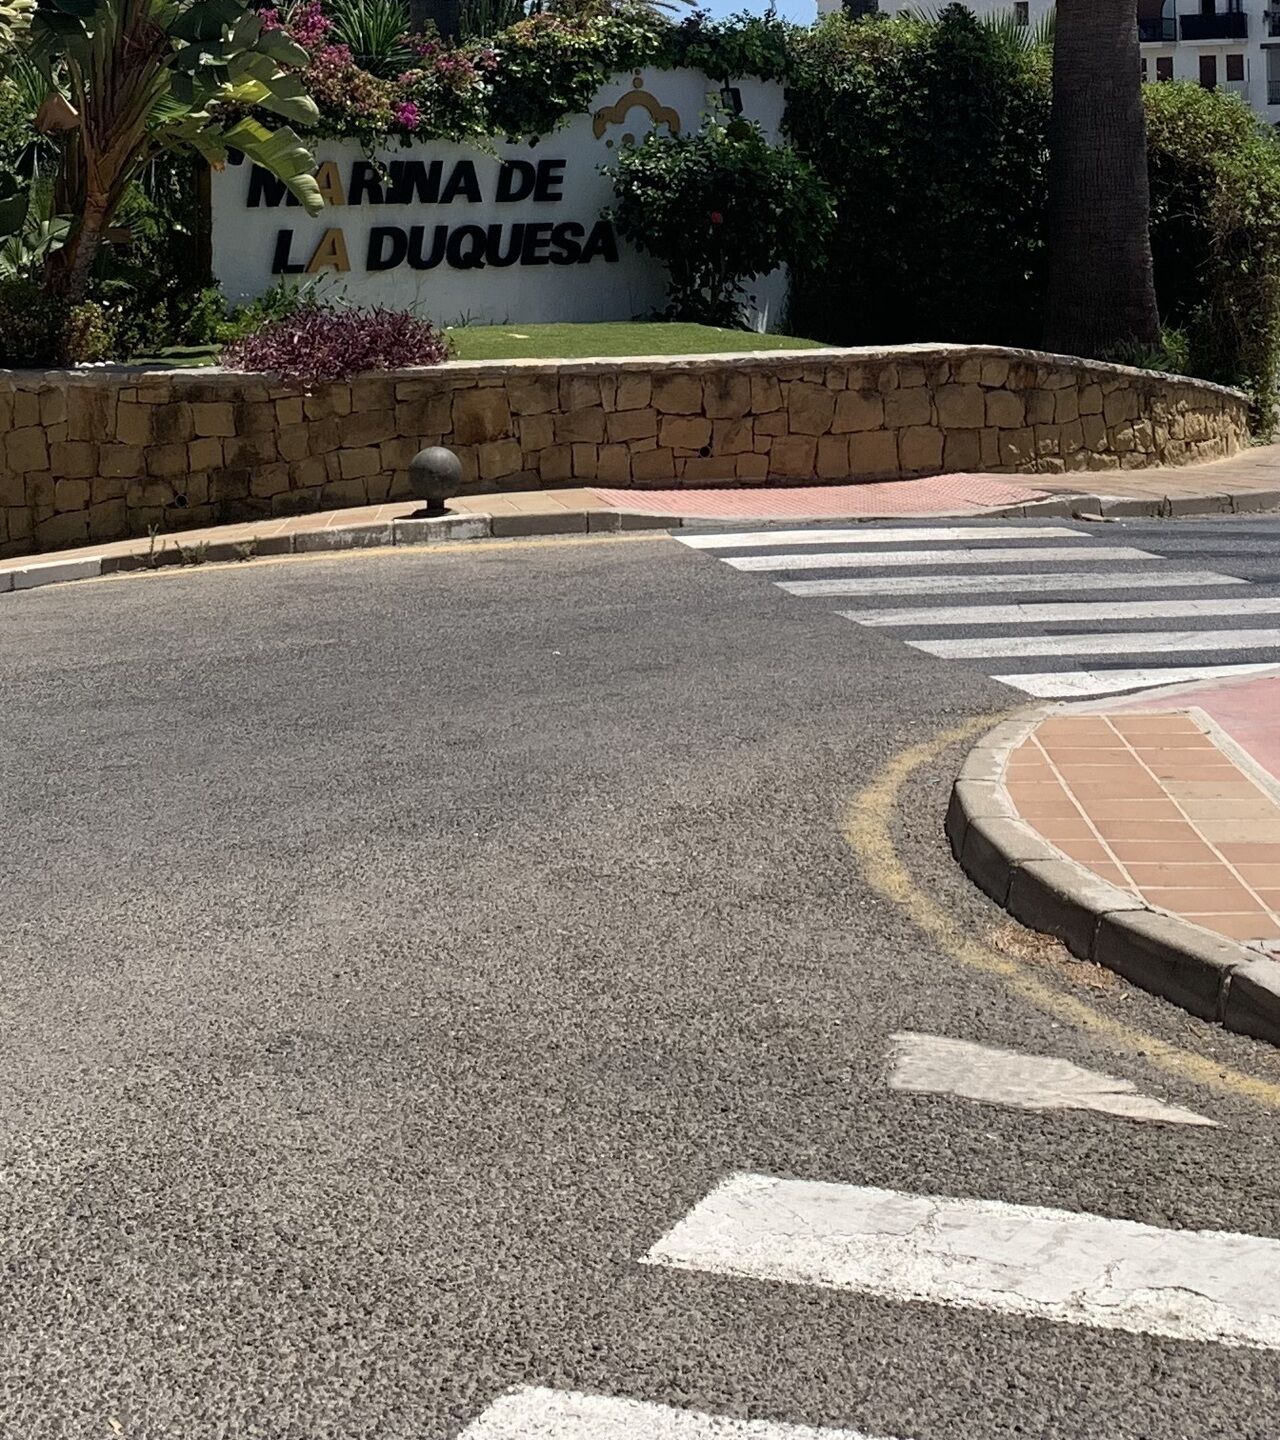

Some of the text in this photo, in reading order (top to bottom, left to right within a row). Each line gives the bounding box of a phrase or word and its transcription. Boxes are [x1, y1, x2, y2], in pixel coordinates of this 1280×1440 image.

[495, 159, 567, 203] DE
[272, 222, 619, 274] LA DUQUESA
